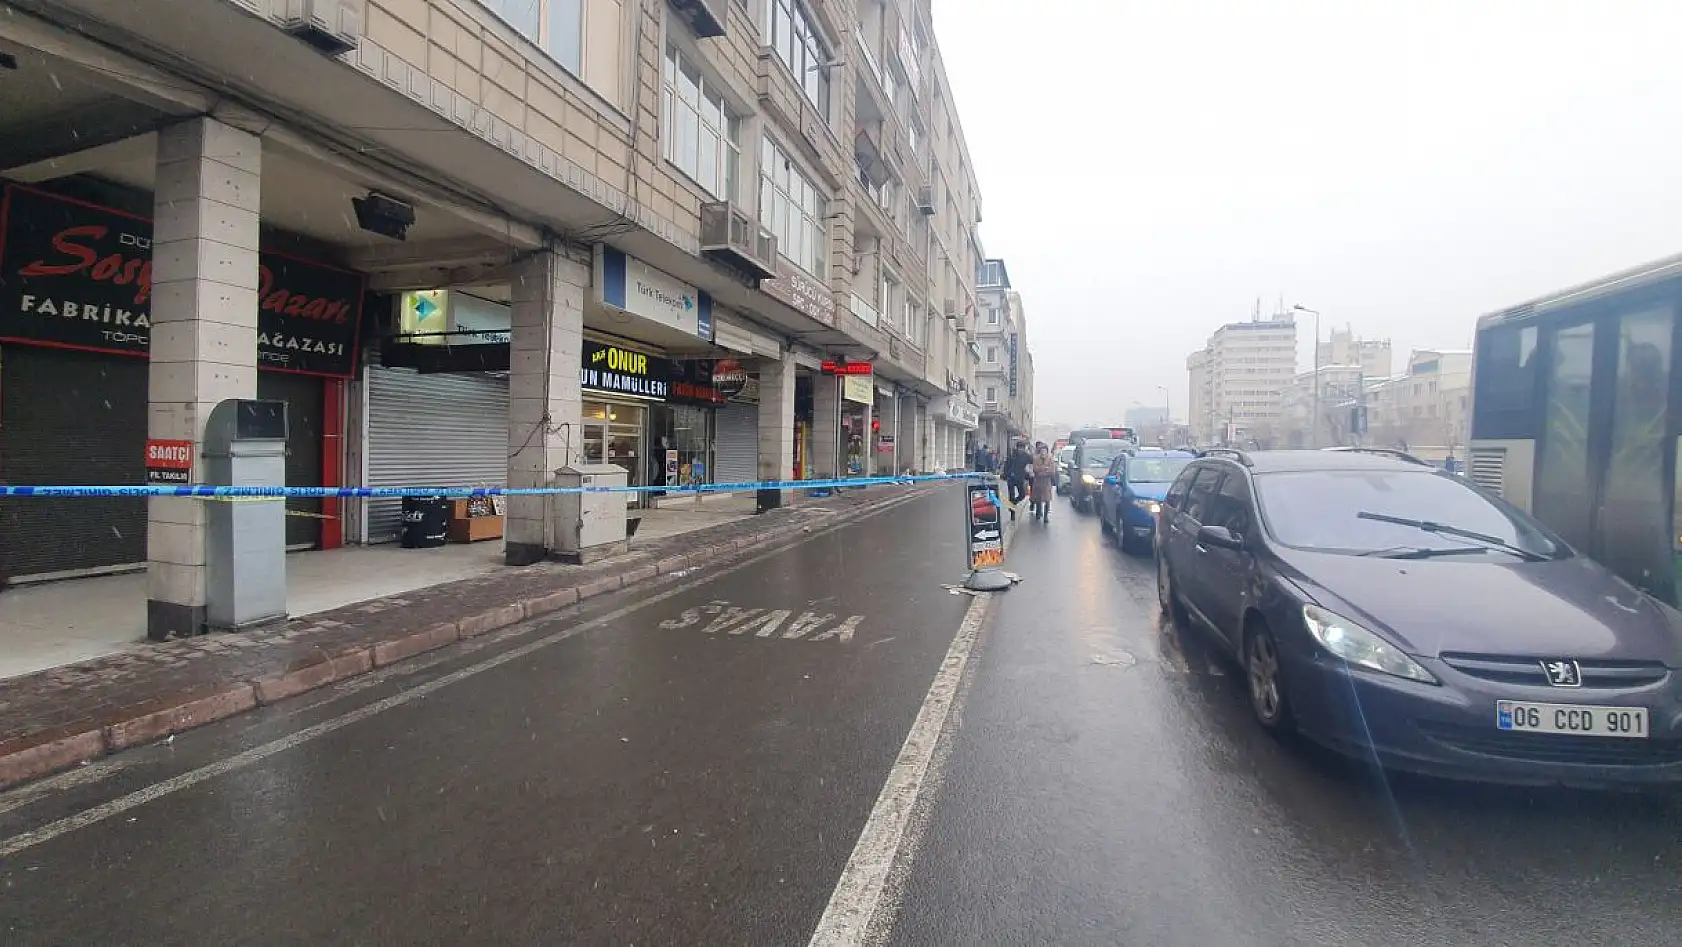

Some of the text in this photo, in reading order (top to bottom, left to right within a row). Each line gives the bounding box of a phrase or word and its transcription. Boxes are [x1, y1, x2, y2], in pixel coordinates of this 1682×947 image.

[636, 280, 653, 297] Türk
[20, 294, 344, 356] FABRİKA AĞAZASI
[607, 347, 648, 375] ONUR
[581, 367, 598, 387] UN
[602, 371, 667, 396] MAMÜLLERİ
[150, 444, 190, 463] SAATÇİ
[1513, 706, 1643, 733] 06 CCD 901
